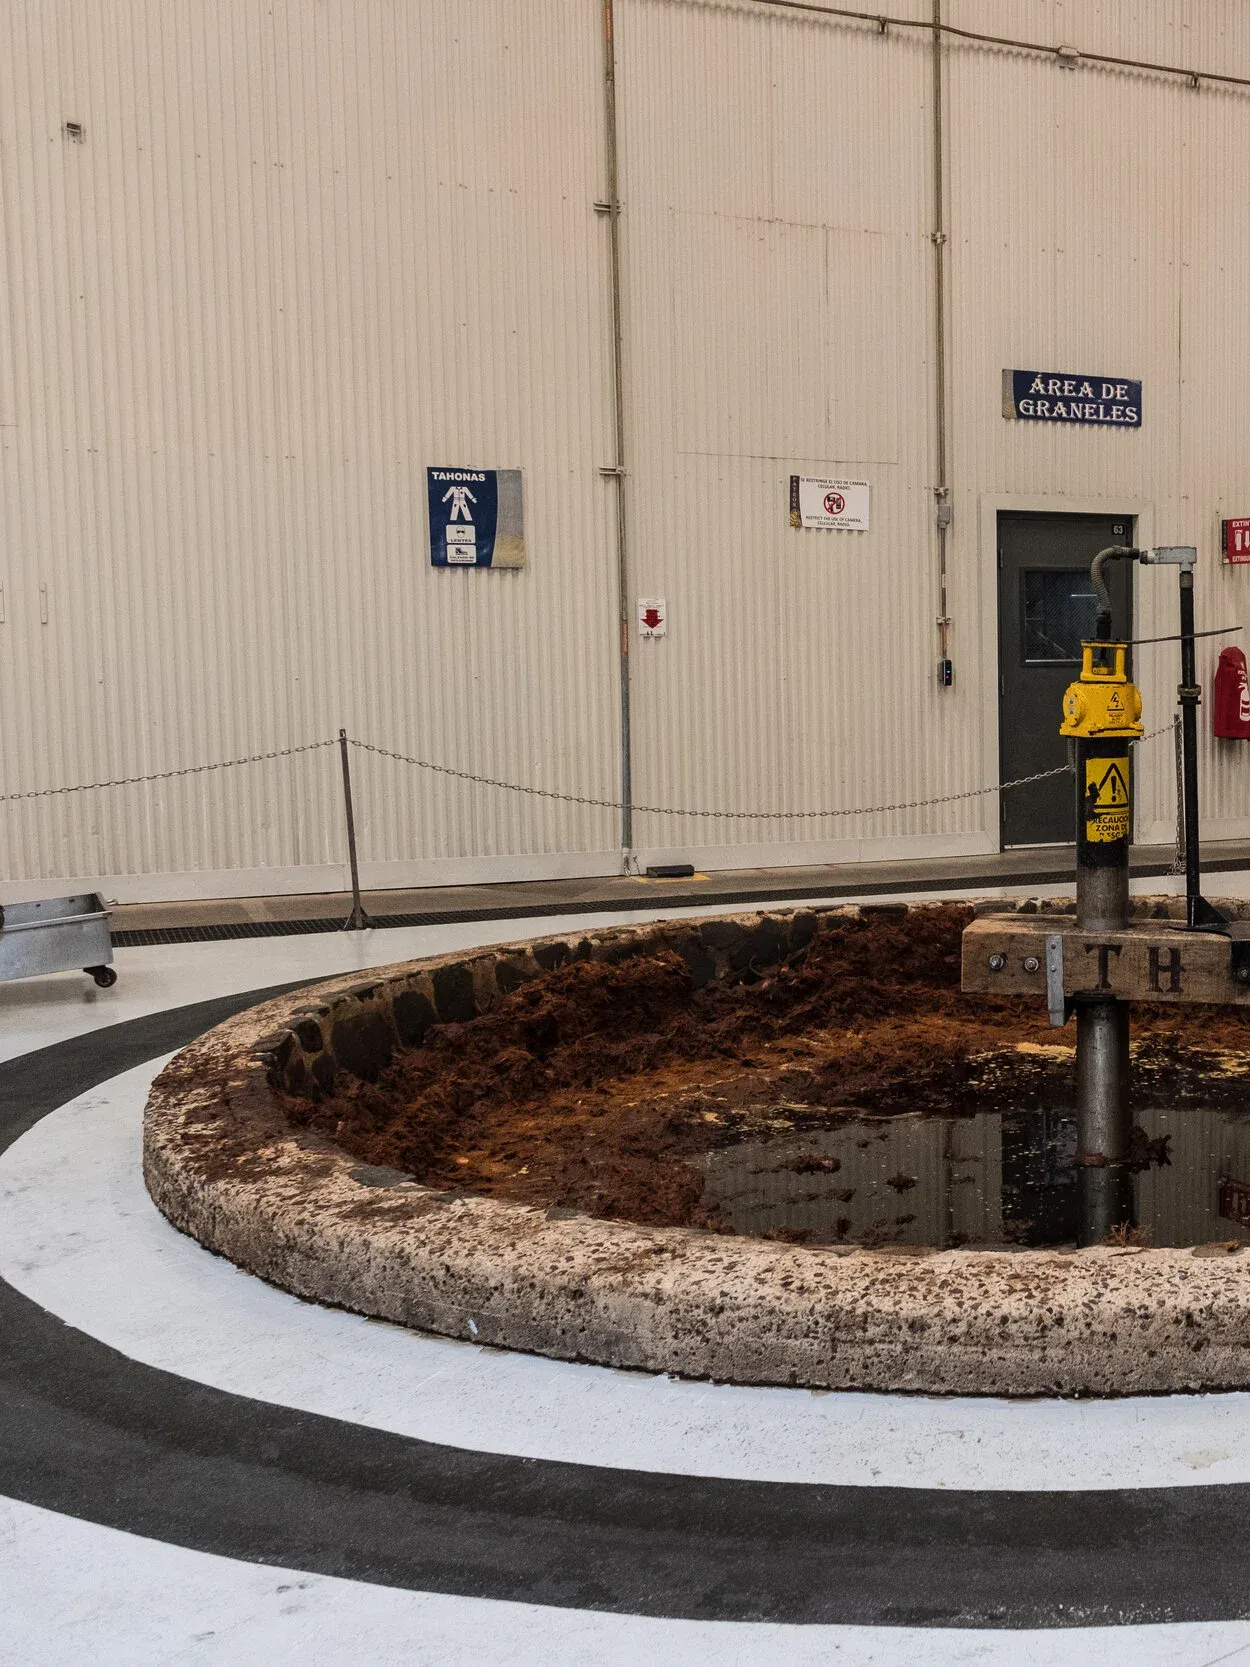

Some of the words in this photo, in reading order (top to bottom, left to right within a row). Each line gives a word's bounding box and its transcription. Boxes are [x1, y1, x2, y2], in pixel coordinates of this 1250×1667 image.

[1029, 374, 1095, 398] ÁREA
[1102, 383, 1130, 401] DE
[1019, 400, 1138, 422] GRANELES
[432, 472, 486, 482] TAHONAS
[1113, 525, 1124, 535] 63
[1096, 824, 1120, 832] ZONA
